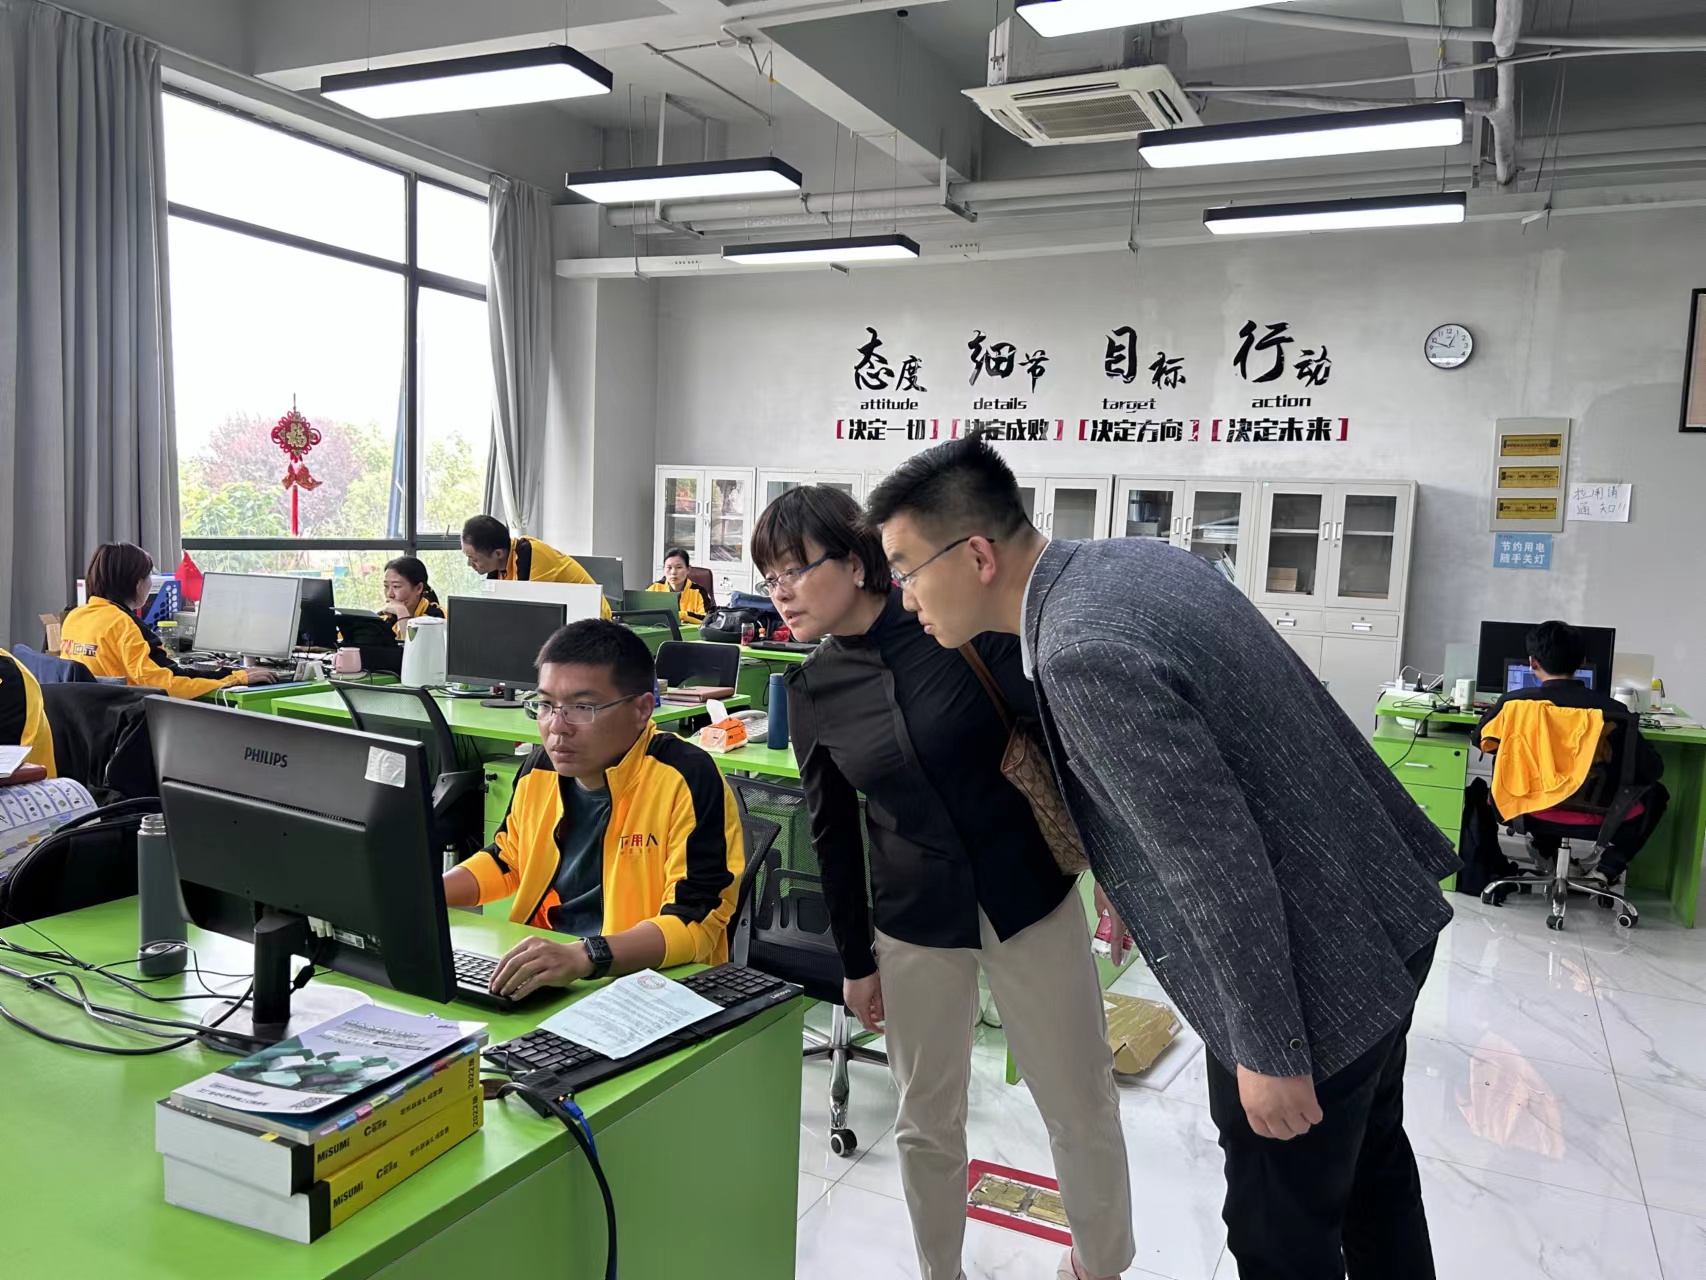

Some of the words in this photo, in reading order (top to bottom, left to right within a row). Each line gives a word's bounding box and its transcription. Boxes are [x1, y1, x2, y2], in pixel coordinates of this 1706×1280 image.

[854, 326, 928, 392] 态度
[967, 329, 1050, 393] 细节
[1104, 325, 1187, 389] 目标
[1233, 319, 1333, 387] 行动
[860, 397, 919, 410] attitude
[973, 397, 1027, 410] details
[1102, 397, 1156, 413] target
[1251, 394, 1311, 408] action
[1501, 541, 1545, 553] 节约用电
[1500, 553, 1546, 565] 随手关灯
[244, 747, 288, 768] PHILIPS
